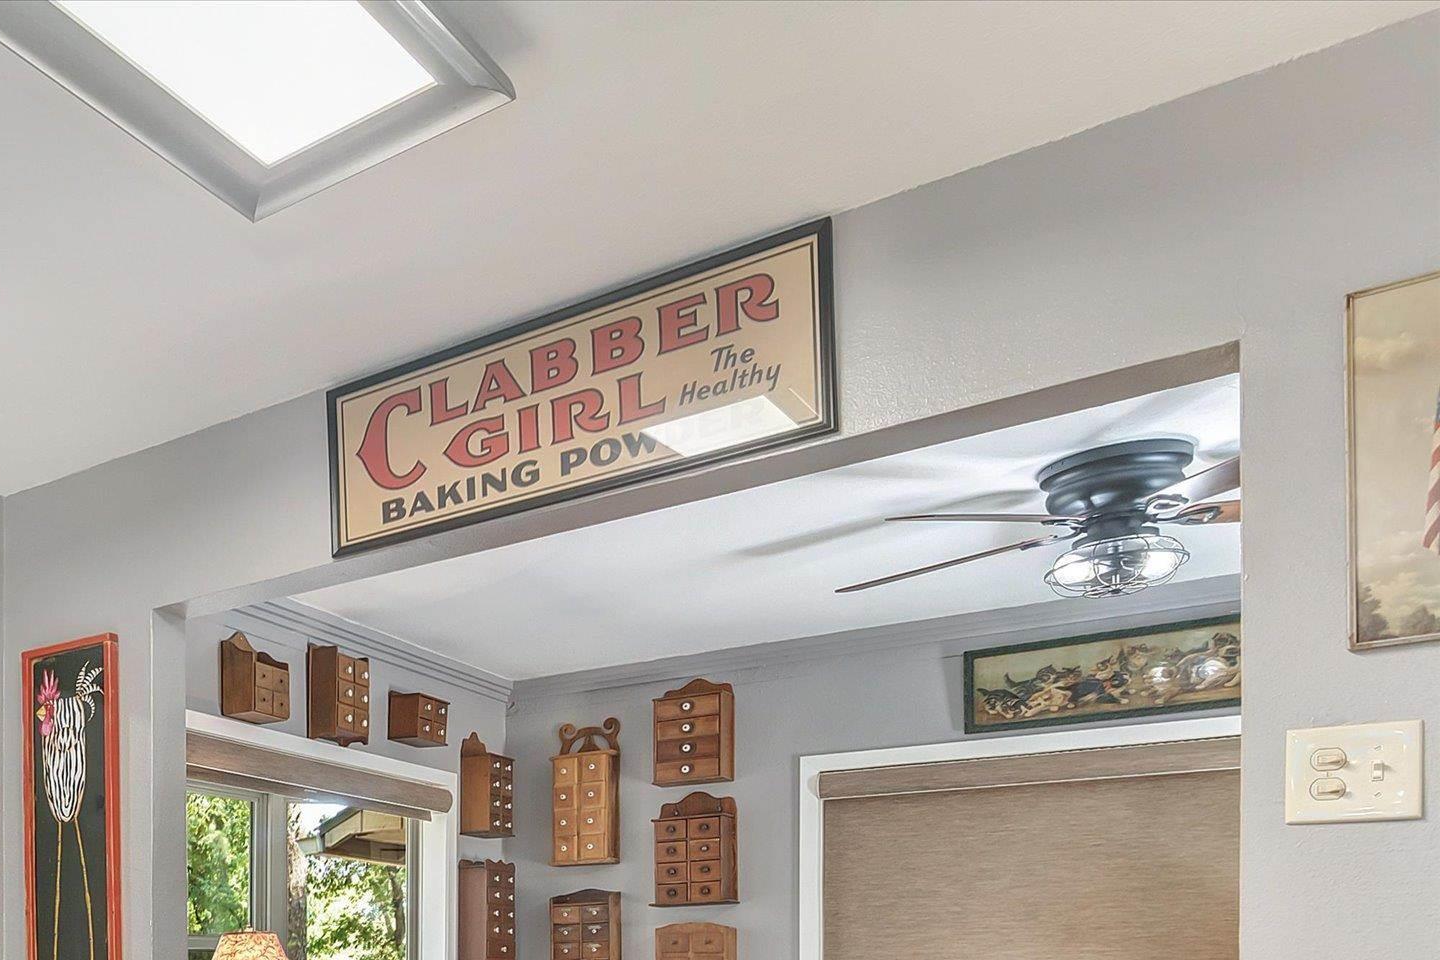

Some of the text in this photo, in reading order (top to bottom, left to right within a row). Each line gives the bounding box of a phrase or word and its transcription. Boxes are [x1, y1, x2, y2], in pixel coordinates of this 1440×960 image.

[356, 273, 780, 490] CLABBER
[678, 362, 782, 407] Healthy
[711, 344, 756, 373] The
[443, 372, 666, 468] GIRL
[382, 460, 540, 524] BAKING
